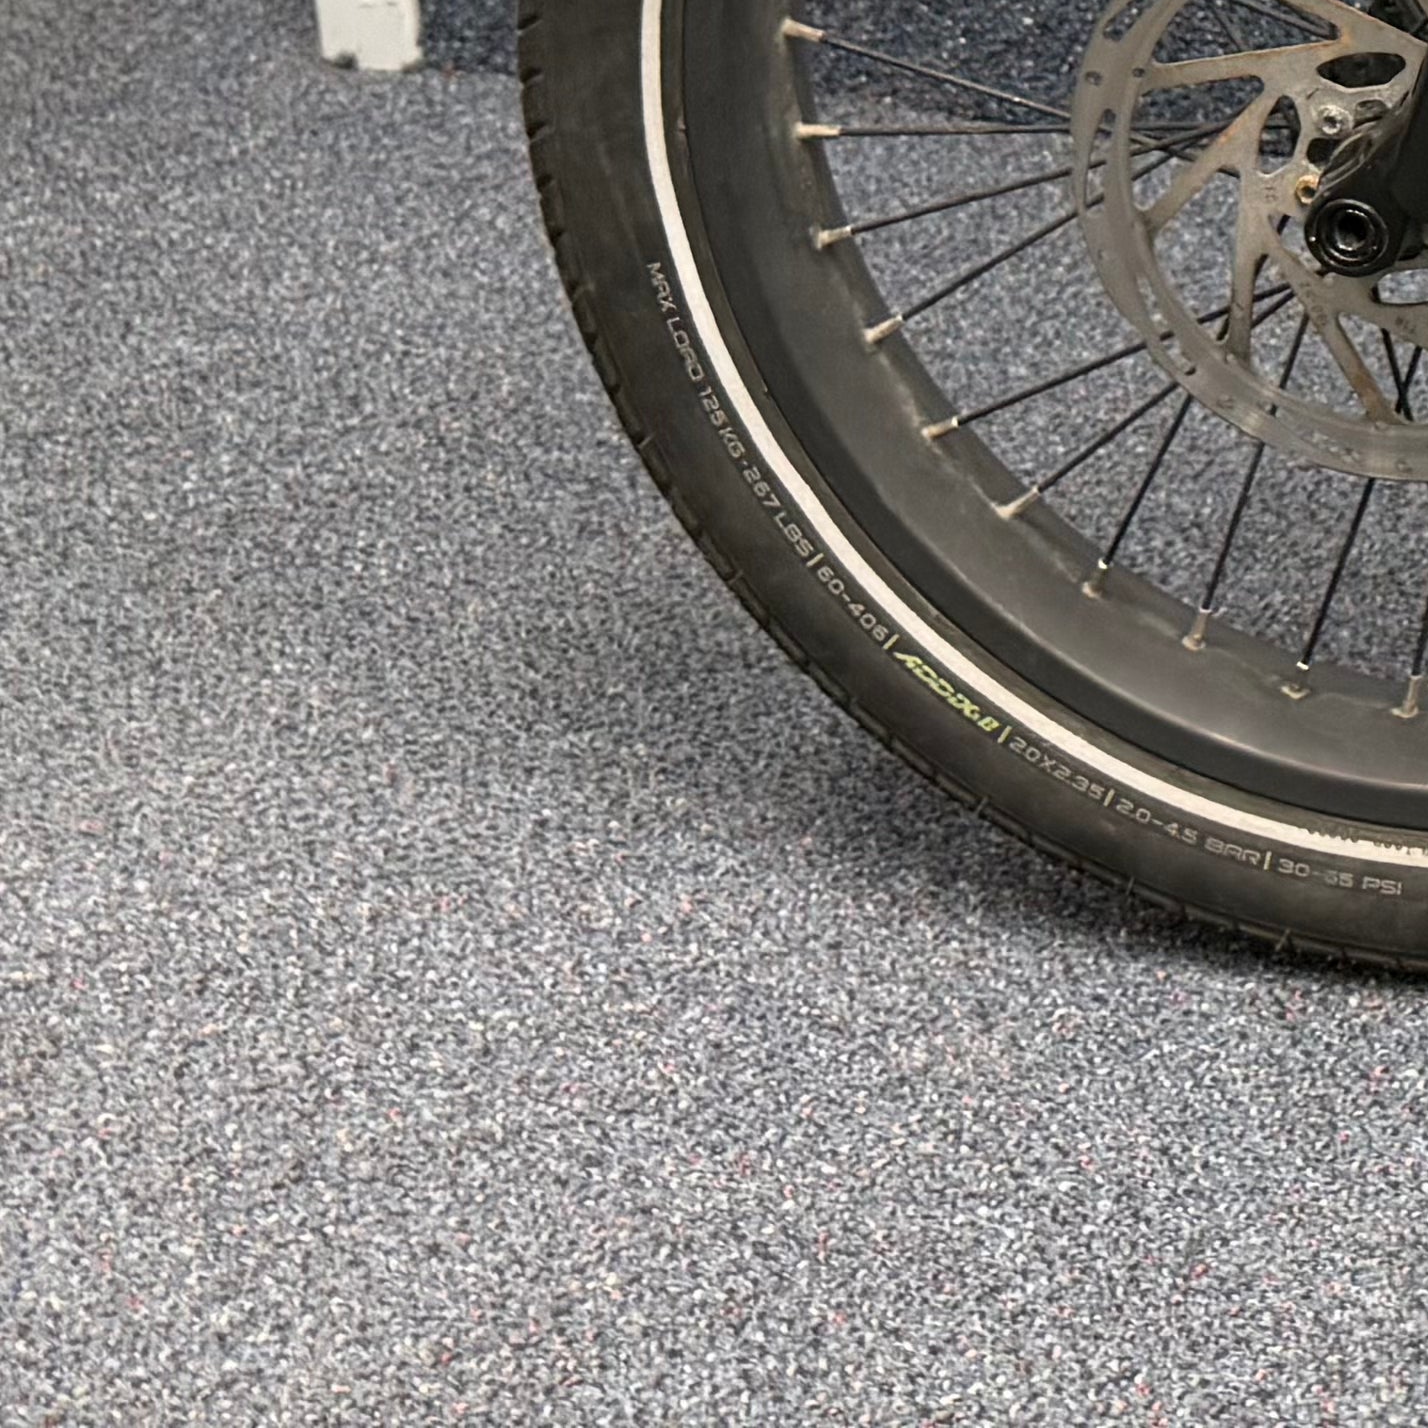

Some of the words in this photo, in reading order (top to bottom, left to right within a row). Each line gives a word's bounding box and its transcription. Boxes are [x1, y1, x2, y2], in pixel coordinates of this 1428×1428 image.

[646, 261, 677, 312] MAX
[666, 316, 705, 381] LOAD
[700, 385, 729, 427] 125
[817, 566, 889, 641] 60-406
[1203, 836, 1261, 866] BAR
[1361, 875, 1403, 895] PSI
